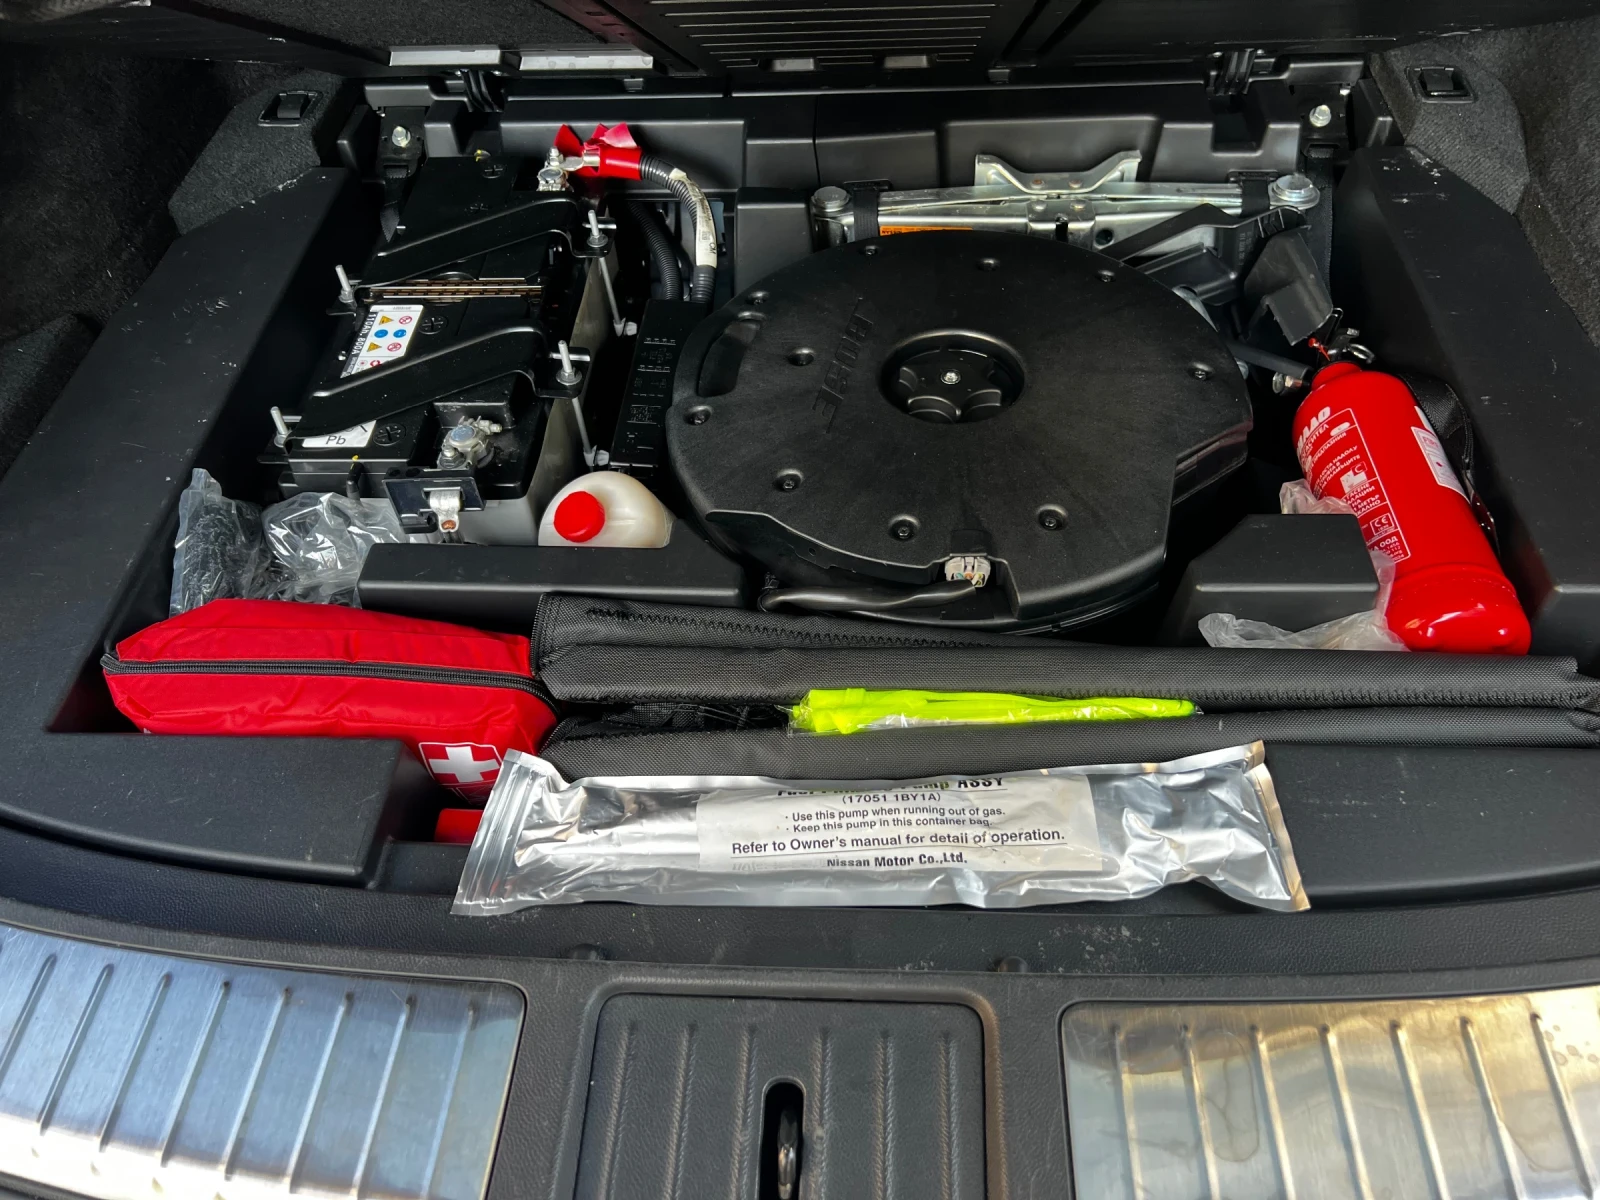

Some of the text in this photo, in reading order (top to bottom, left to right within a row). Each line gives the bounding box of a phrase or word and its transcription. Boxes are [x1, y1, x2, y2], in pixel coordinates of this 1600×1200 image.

[352, 337, 366, 355] 800A
[325, 435, 347, 445] Pb
[842, 793, 887, 804] (17051
[895, 791, 941, 802] 1BY1A)
[792, 805, 1006, 821] Use this pump when running out of gas.
[793, 817, 993, 832] Keep this pump in this container bag.
[732, 842, 769, 854] Refer
[772, 840, 786, 851] to
[790, 836, 847, 850] Owner's
[851, 834, 901, 847] manual
[905, 833, 925, 844] for
[972, 831, 987, 844] of
[991, 829, 1065, 845] operation.
[827, 858, 870, 867] Nissan
[874, 856, 914, 867] Motor
